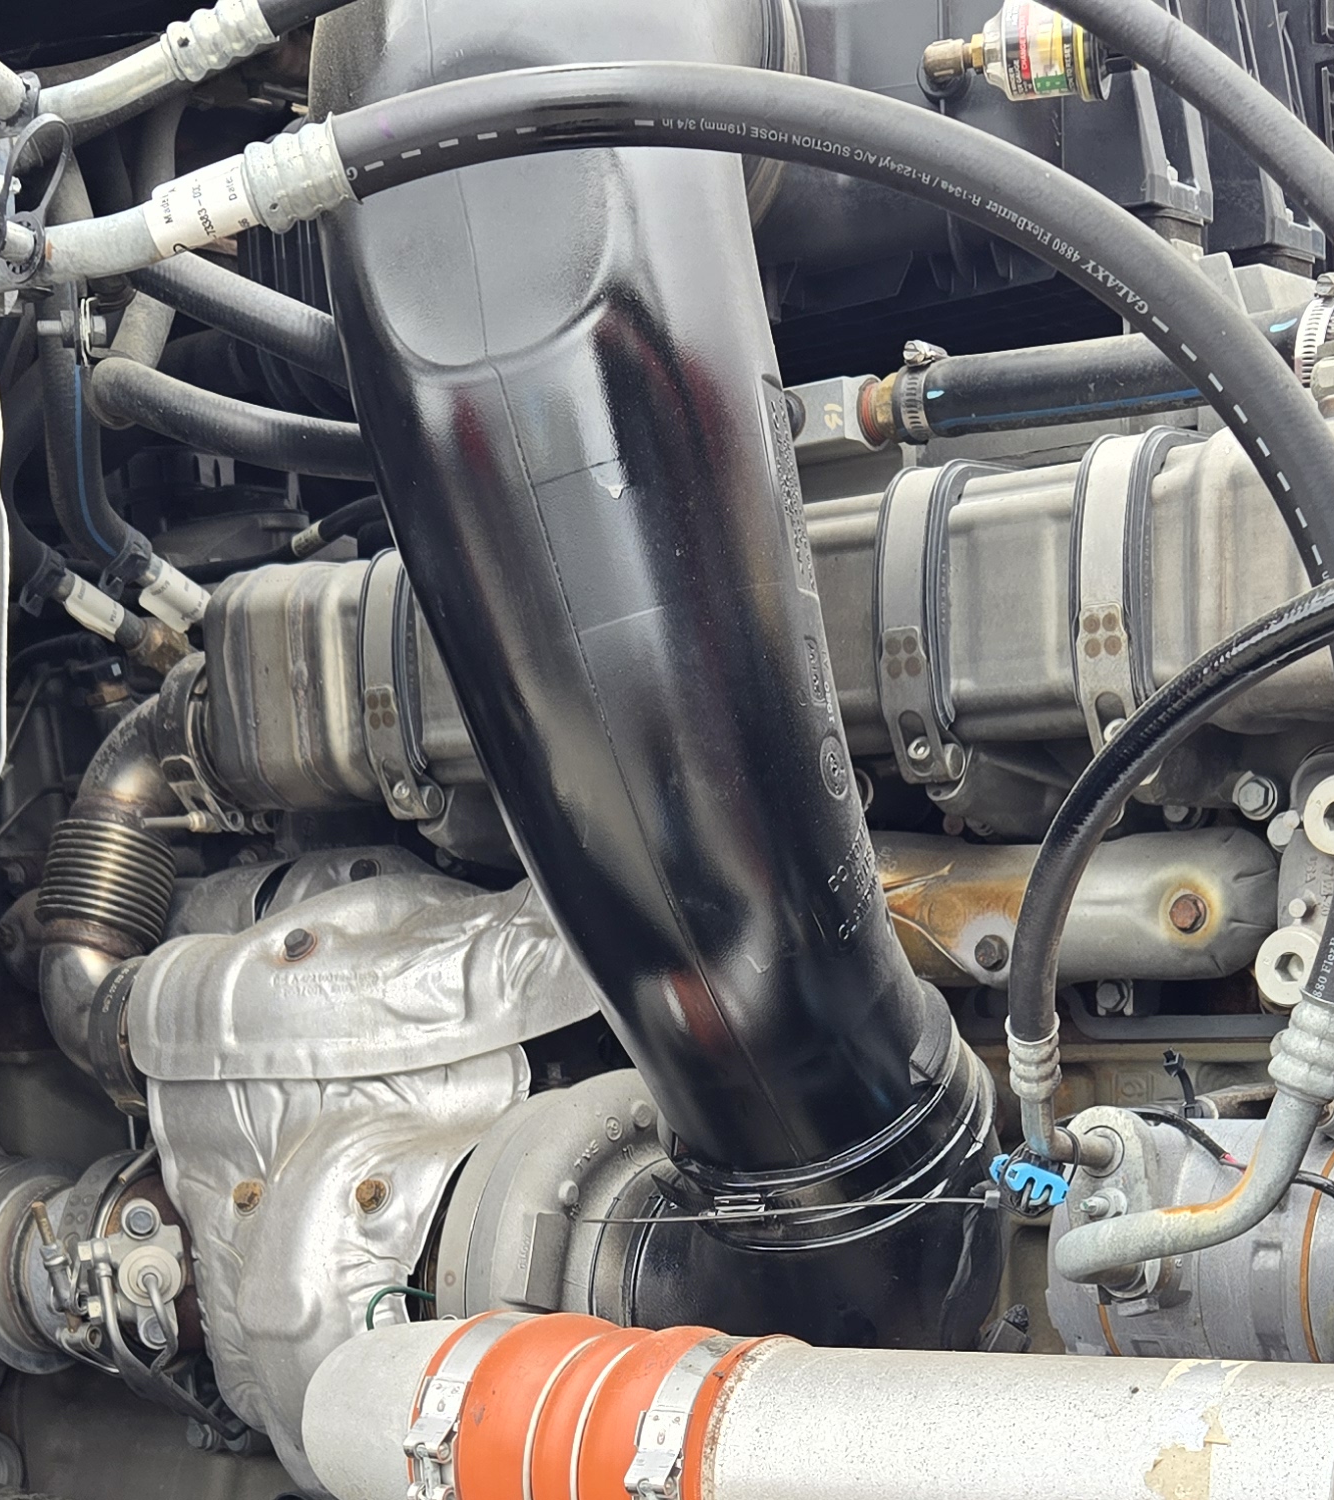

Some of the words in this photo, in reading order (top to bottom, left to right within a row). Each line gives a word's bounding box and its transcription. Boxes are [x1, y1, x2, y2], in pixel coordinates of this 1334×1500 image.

[1019, 39, 1028, 71] CHANGE
[662, 118, 674, 129] in
[676, 119, 696, 130] 3/4
[700, 118, 747, 136] (19mm)
[750, 126, 788, 143] HOSE
[791, 134, 852, 157] SUCTION
[853, 149, 877, 164] A/C
[878, 156, 932, 185] R-1234yf
[931, 176, 941, 188] /
[940, 180, 982, 207] R-134a
[985, 199, 1054, 245] FlexBarrier
[1051, 238, 1081, 263] 4880
[1080, 259, 1149, 314] GALAXY
[1312, 976, 1328, 998] 880
